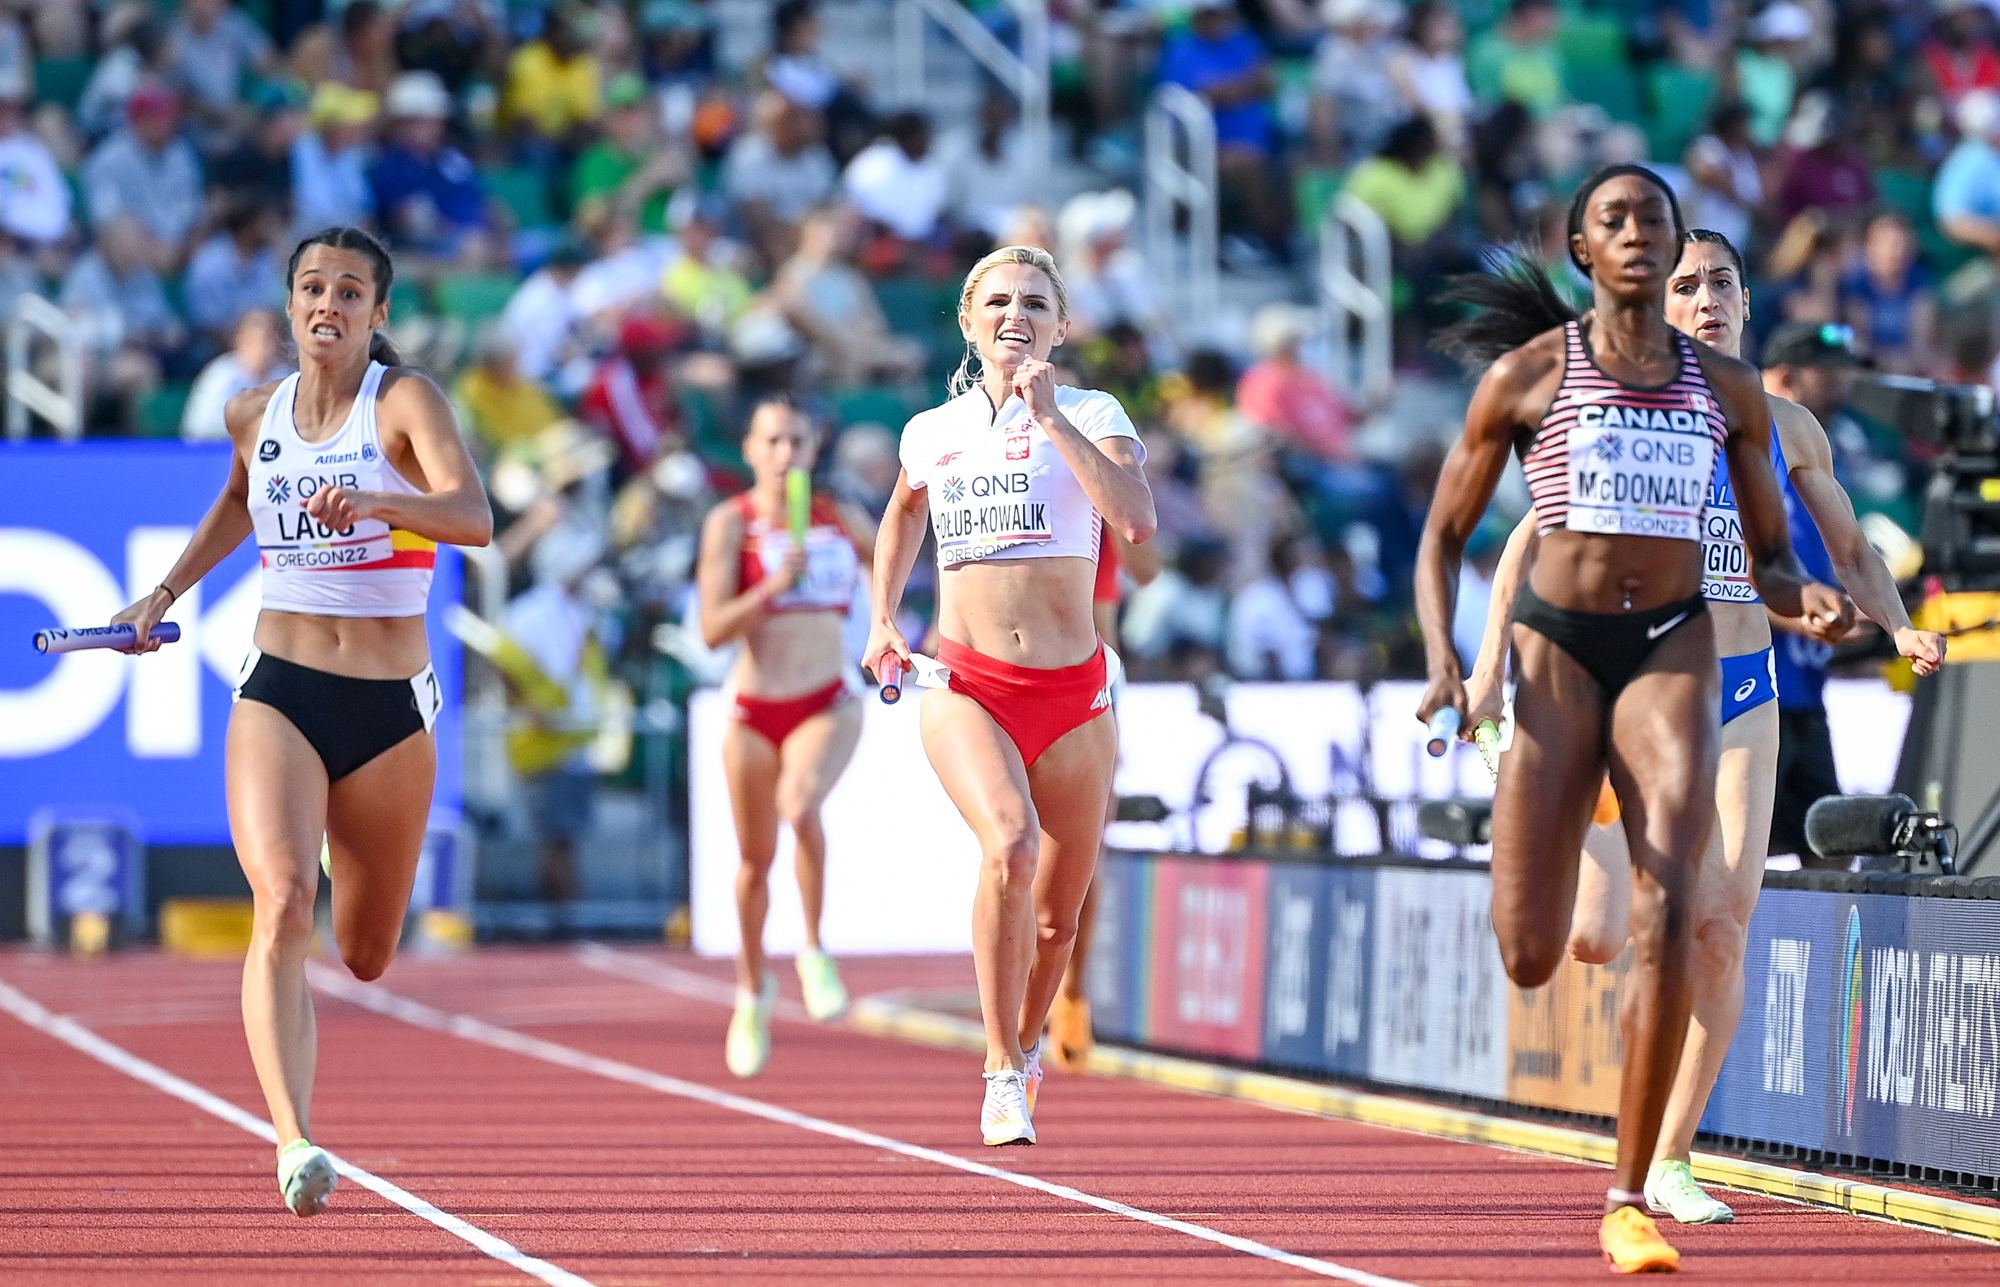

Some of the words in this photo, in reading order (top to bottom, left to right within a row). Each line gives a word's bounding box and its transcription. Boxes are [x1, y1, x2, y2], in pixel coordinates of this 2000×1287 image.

[1577, 405, 1711, 436] CANADA
[315, 452, 358, 465] Allianz
[1632, 437, 1695, 466] QNB
[297, 473, 359, 499] QNB
[972, 473, 1030, 497] QNB
[1578, 470, 1701, 508] McDONALD
[1593, 513, 1691, 534] OREGON22
[276, 547, 368, 567] OREGON22
[1866, 945, 1920, 1106] WORLD
[1920, 952, 2000, 1119] ATHLETICS
